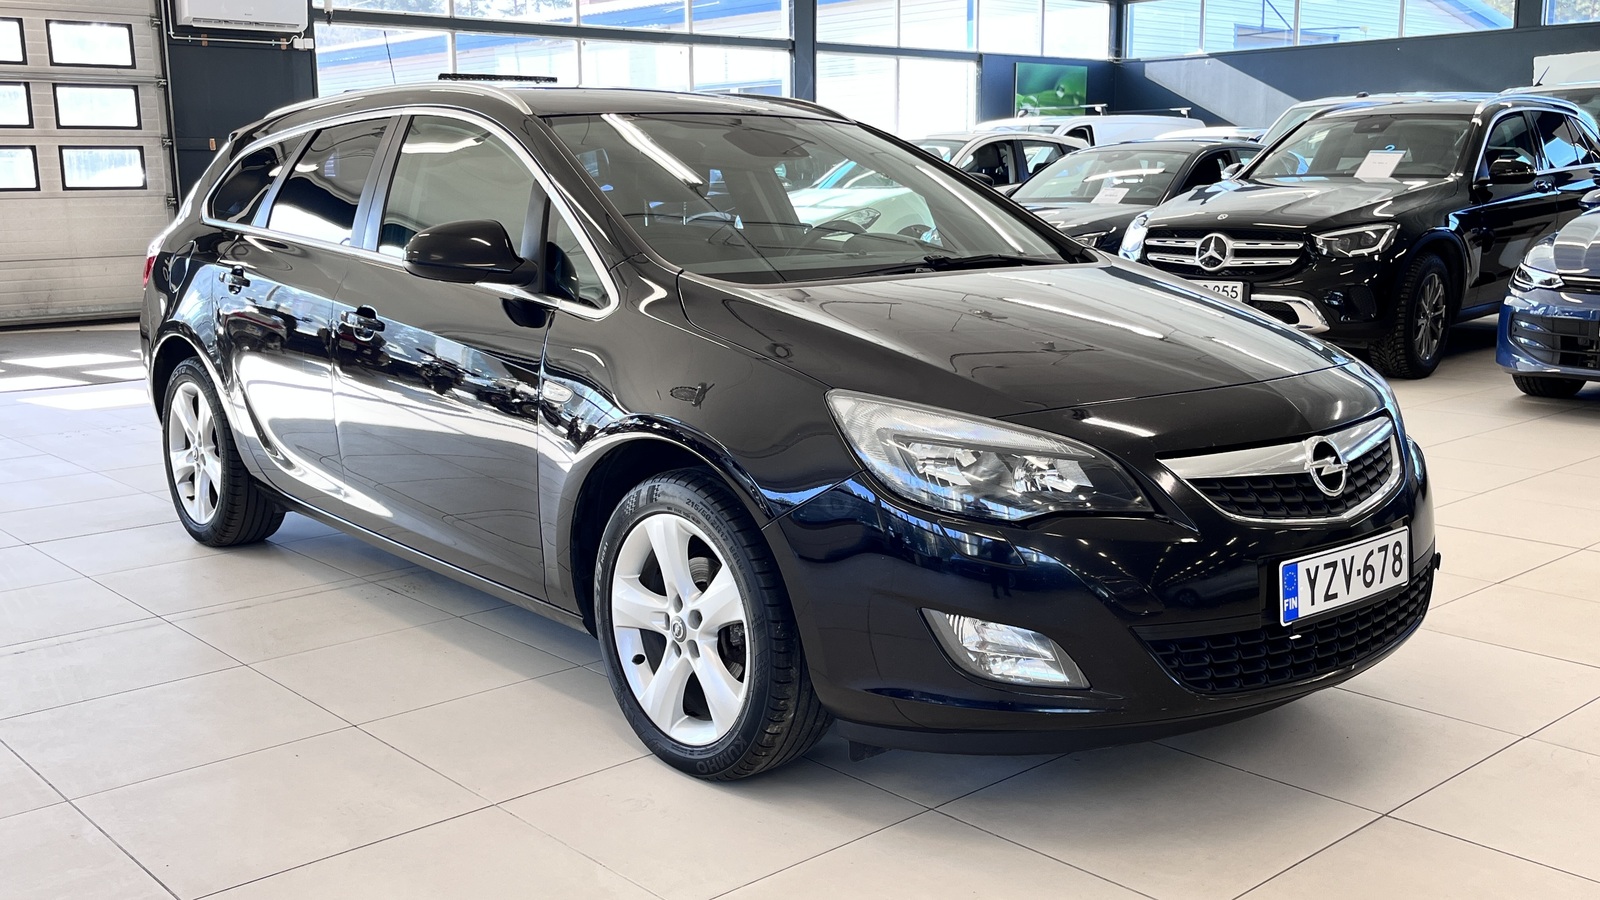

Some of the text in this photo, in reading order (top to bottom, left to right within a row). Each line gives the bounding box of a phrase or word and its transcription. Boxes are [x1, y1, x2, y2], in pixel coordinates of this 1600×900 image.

[1305, 541, 1403, 606] YZV-678
[1284, 597, 1298, 612] FIN
[696, 734, 748, 774] KUMHO
